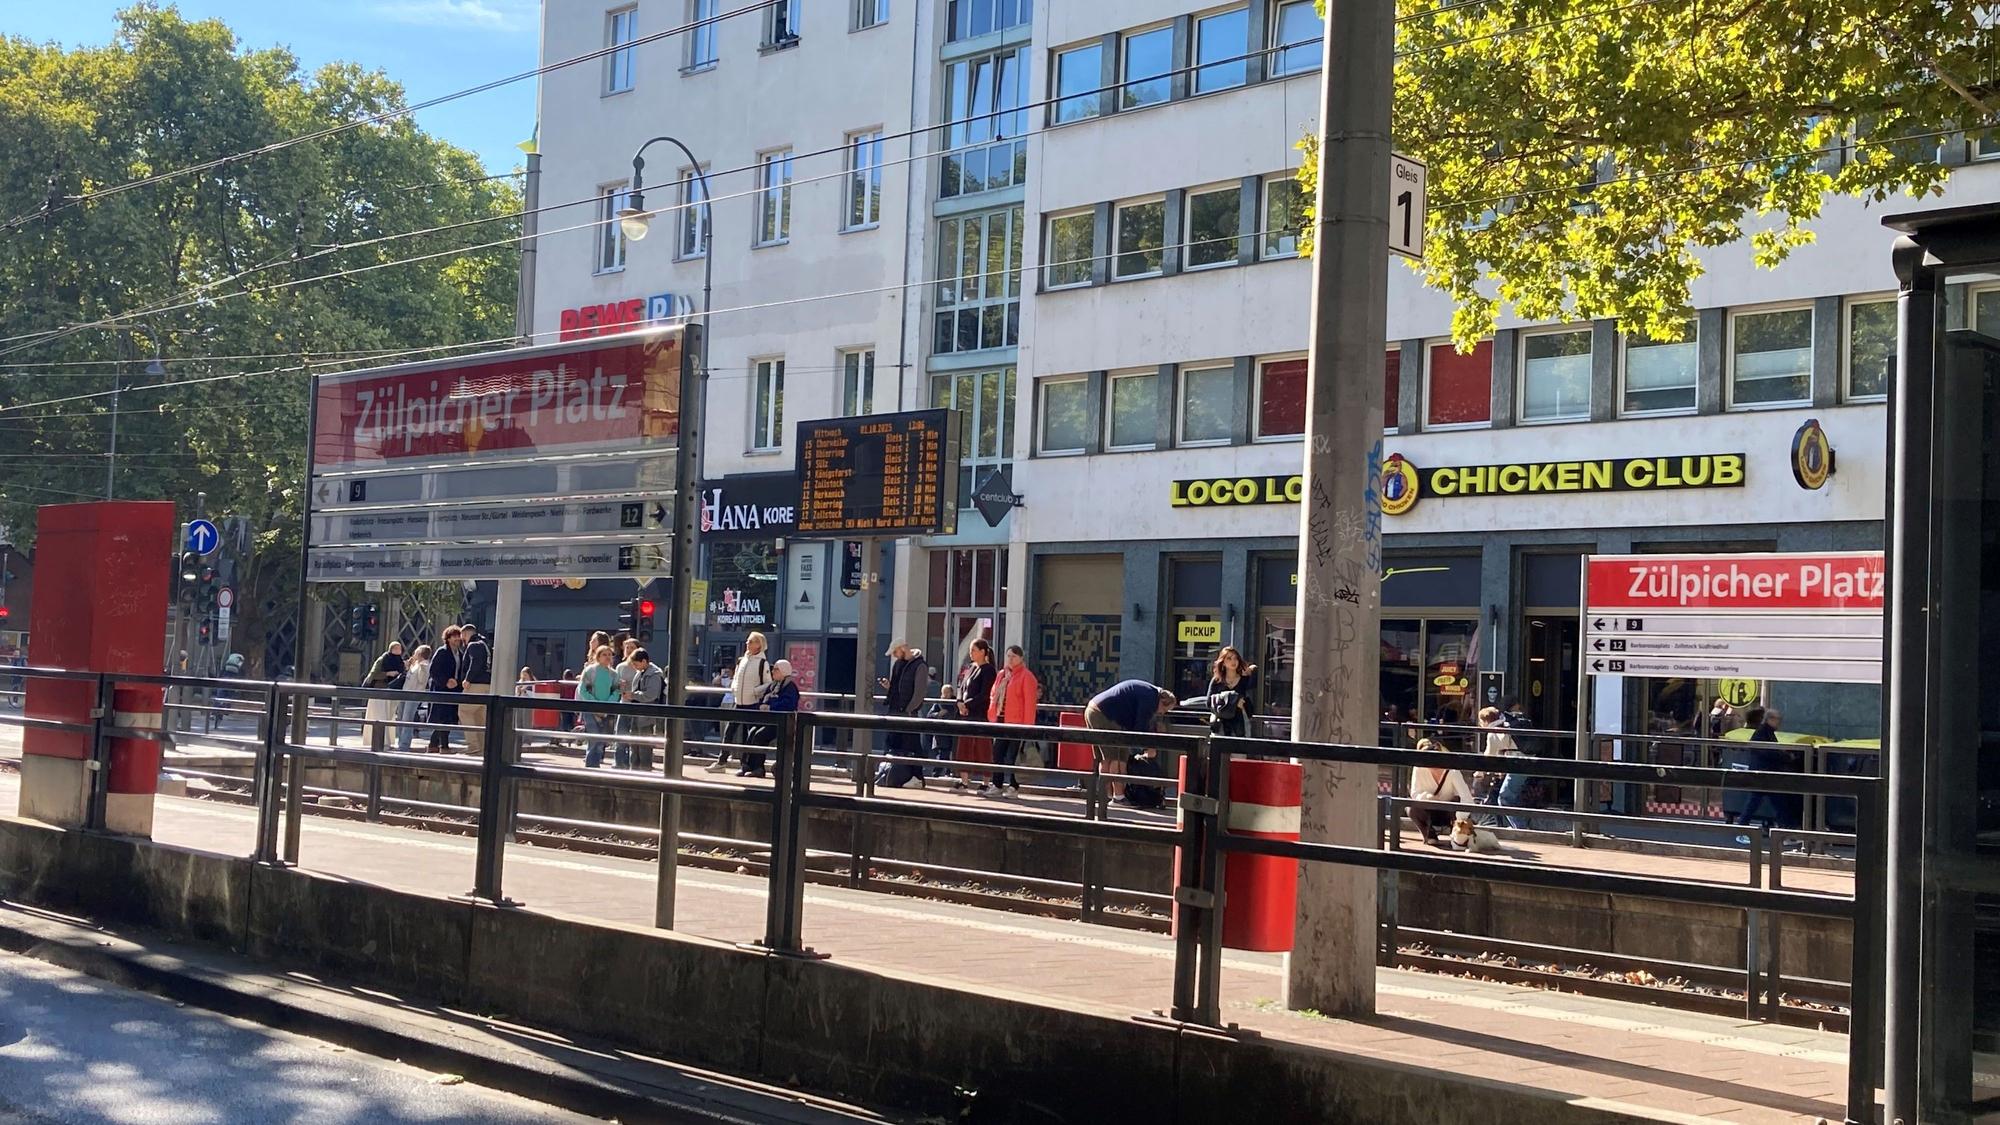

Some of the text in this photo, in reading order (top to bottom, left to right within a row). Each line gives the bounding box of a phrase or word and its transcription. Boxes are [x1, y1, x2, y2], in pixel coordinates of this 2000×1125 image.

[1396, 163, 1418, 184] Gleis
[1397, 191, 1412, 247] 1
[353, 363, 627, 452] Zülpicher Platz
[885, 433, 902, 443] Gleis
[927, 430, 939, 439] Min
[885, 443, 902, 453] Gleis
[926, 441, 938, 450] Min
[885, 453, 902, 464] Gleis
[926, 452, 937, 461] Min
[884, 464, 901, 474] Gleis
[925, 462, 937, 472] Min
[884, 475, 901, 485] Gleis
[925, 473, 937, 482] Min
[1431, 454, 1744, 495] CHICKEN CLUB
[883, 485, 900, 495] Gleis
[924, 484, 936, 493] Min
[1170, 476, 1303, 506] LOCO LO
[883, 496, 900, 506] Gleis
[924, 494, 936, 504] Min
[624, 507, 639, 524] 12
[705, 488, 795, 531] HANA KORE
[882, 507, 900, 516] Gleis
[923, 505, 935, 514] Min
[577, 553, 613, 564] Chorweiler
[1628, 562, 1884, 605] Zülpicher Platz
[731, 590, 761, 613] HANA
[717, 614, 766, 624] KOREAN KITCHEN
[1184, 626, 1216, 637] PICKUP
[1612, 641, 1623, 650] 12
[1612, 661, 1622, 670] 15
